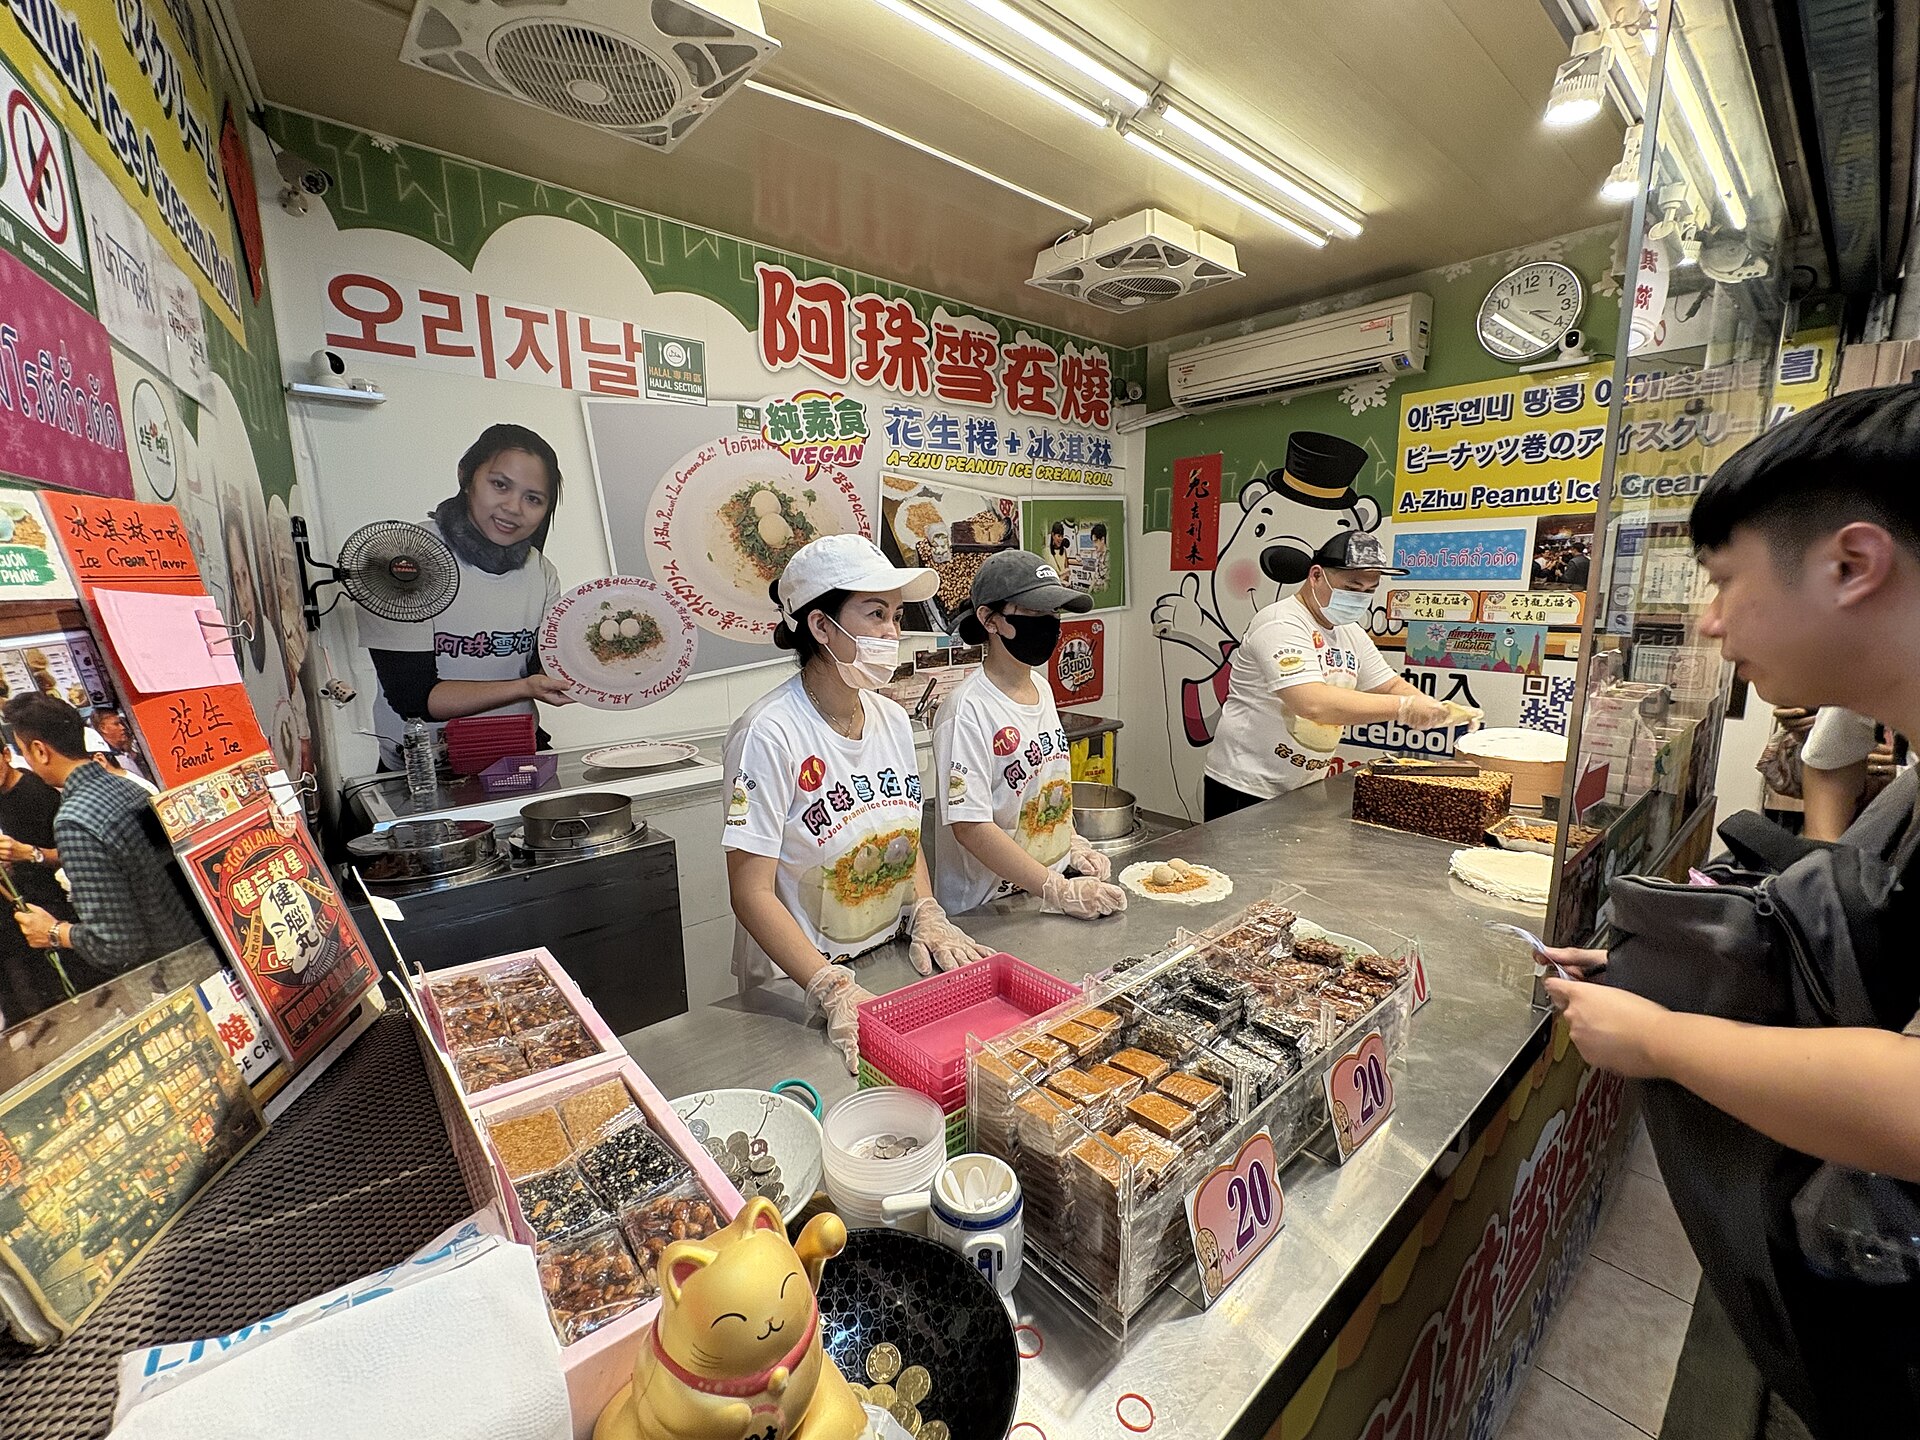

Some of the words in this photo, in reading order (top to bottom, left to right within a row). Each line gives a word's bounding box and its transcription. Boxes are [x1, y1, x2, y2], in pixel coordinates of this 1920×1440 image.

[92, 46, 147, 190] Ice
[146, 134, 212, 285] Cream
[207, 231, 240, 320] Roll
[1510, 283, 1522, 296] 11
[1525, 275, 1539, 288] 12
[1549, 276, 1554, 287] 1
[1556, 284, 1567, 296] 2
[1497, 298, 1510, 311] 10
[1561, 298, 1571, 310] 3
[1541, 329, 1550, 340] 5
[1554, 316, 1563, 327] 4
[326, 274, 642, 398] 오리지날
[758, 267, 1112, 427] 阿珠雪在燒
[649, 366, 672, 379] HALAL
[649, 377, 673, 390] HALAL
[674, 382, 702, 394] SECTION
[765, 397, 868, 441] 純素食
[1408, 393, 1514, 427] 아주언니
[1523, 384, 1583, 413] 땅콩
[790, 445, 863, 465] VEGAN
[887, 451, 943, 470] A-ZHU
[945, 455, 1007, 476] PEANUT
[1009, 462, 1033, 478] ICE
[1035, 466, 1081, 484] CREAM
[1084, 471, 1114, 487] ROLL
[1399, 488, 1466, 511] A-Zhu
[1471, 479, 1561, 506] Peanut
[1621, 473, 1707, 496] Crea
[75, 550, 101, 569] Ice
[107, 548, 148, 568] Cream
[149, 549, 188, 570] Flavor
[1, 567, 40, 586] PHỤNG
[170, 692, 234, 744] 花生
[171, 741, 215, 773] Peanut
[223, 738, 243, 755] Ice
[817, 822, 843, 847] A-Jou
[868, 802, 881, 811] Ice
[218, 1013, 255, 1057] 燒
[1353, 1054, 1385, 1122] 20
[1228, 1160, 1272, 1252] 20
